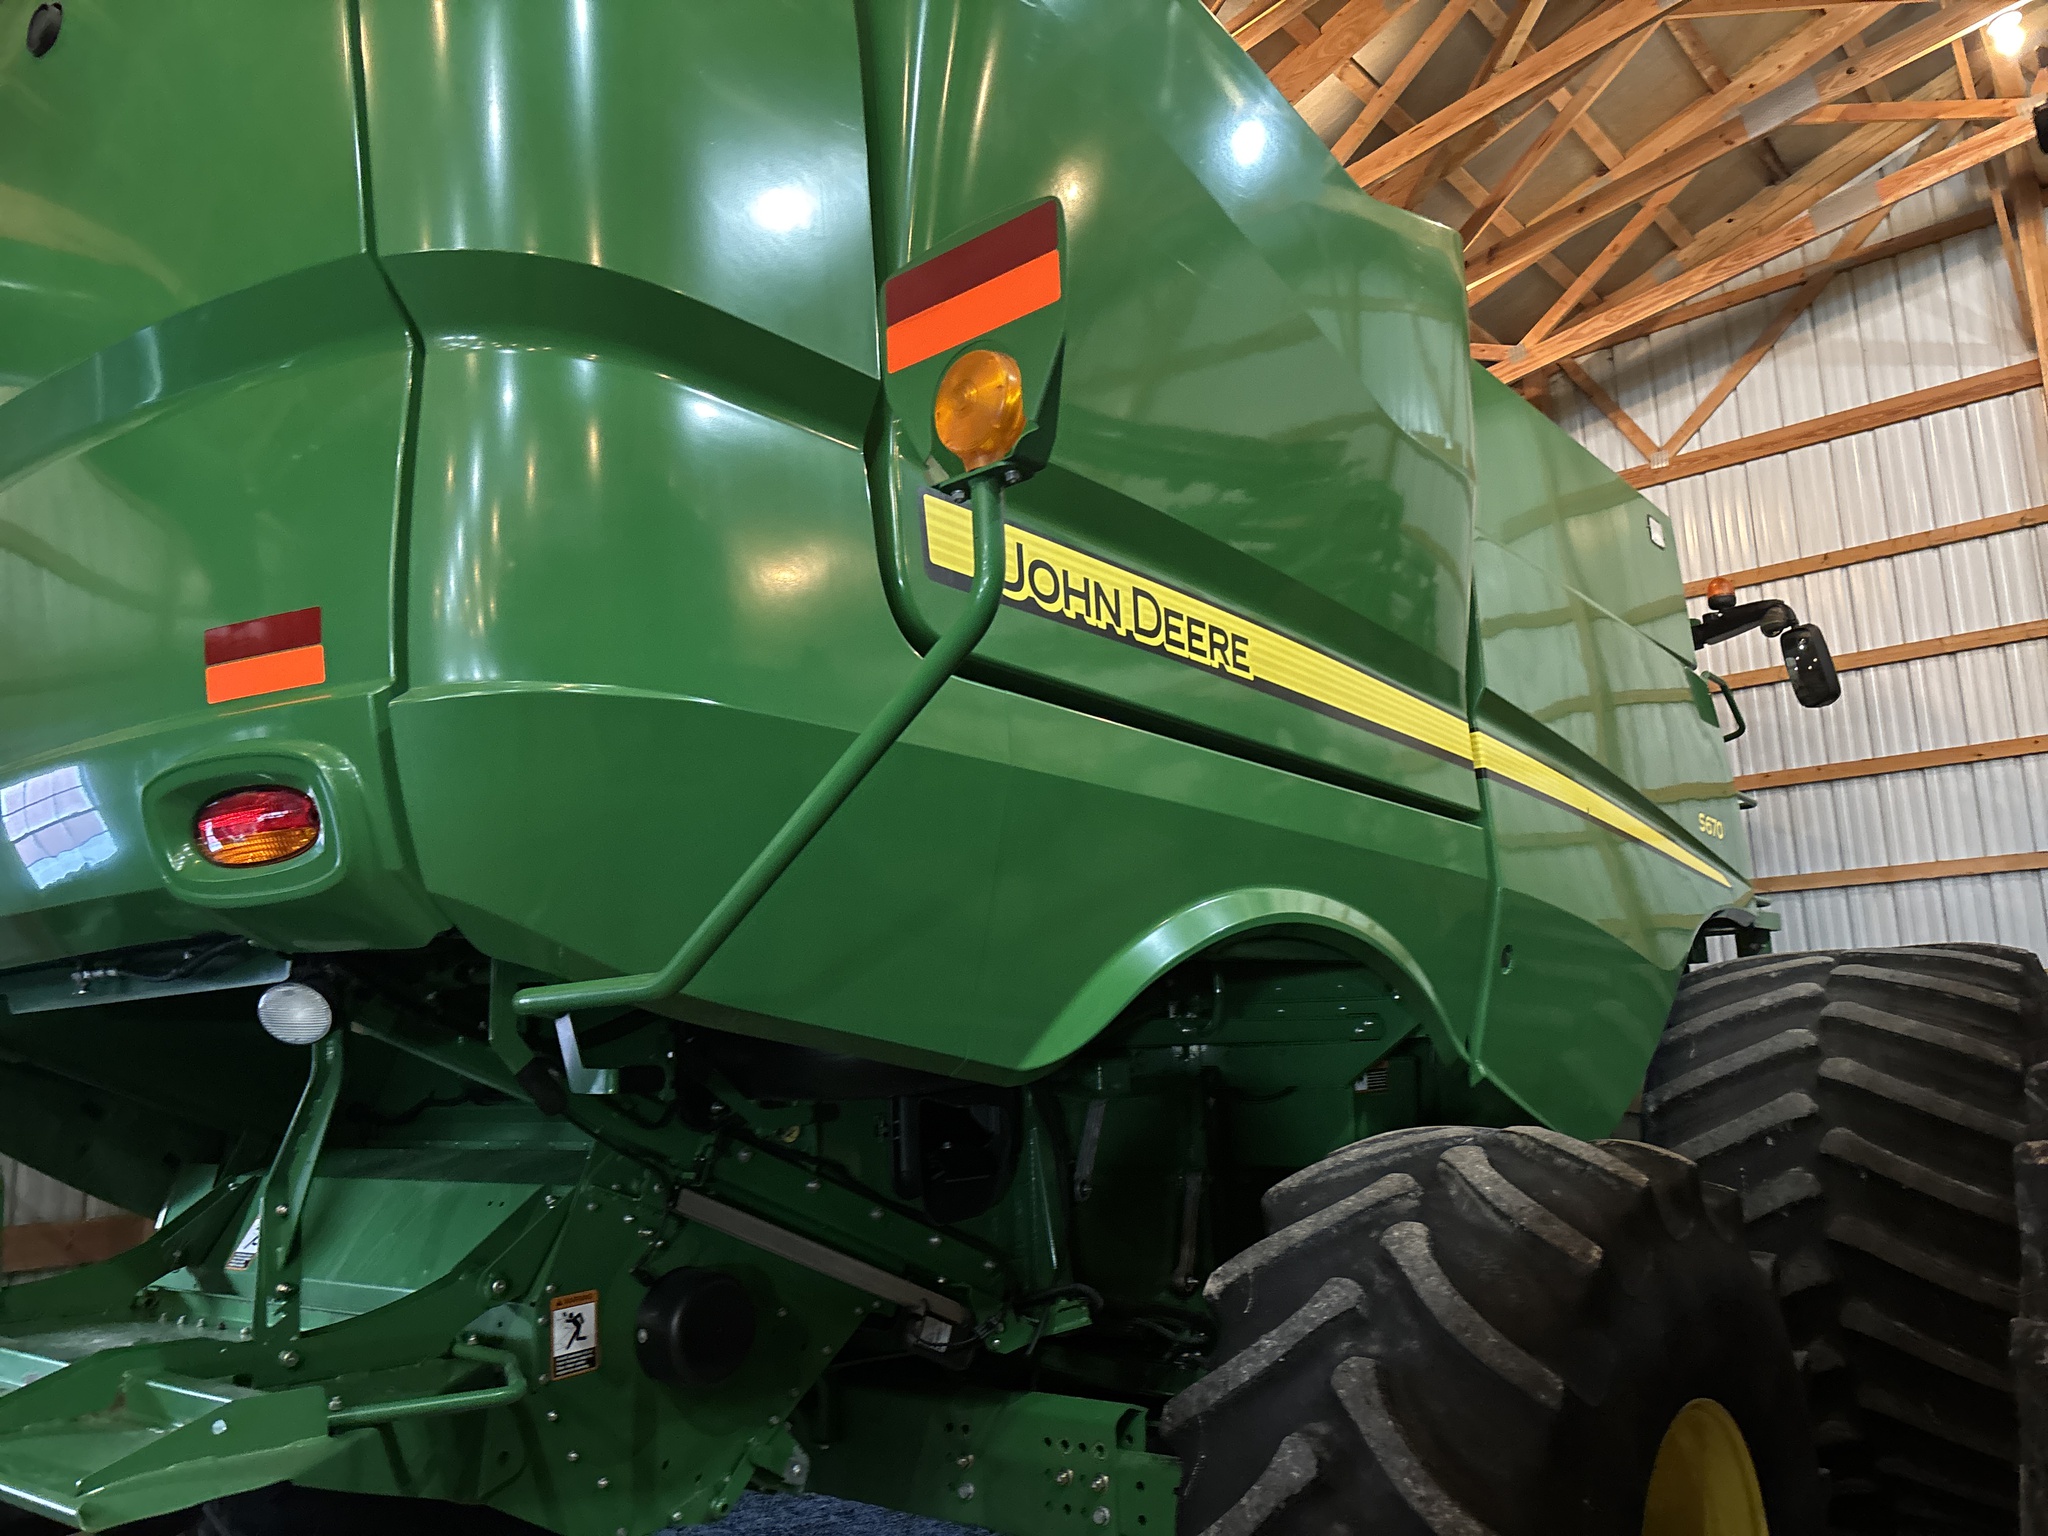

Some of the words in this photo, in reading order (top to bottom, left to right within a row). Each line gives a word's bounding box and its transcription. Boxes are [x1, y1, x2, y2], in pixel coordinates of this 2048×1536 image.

[1003, 542, 1122, 629] JOHN
[1133, 586, 1250, 673] DEERE
[1698, 812, 1724, 840] S670
